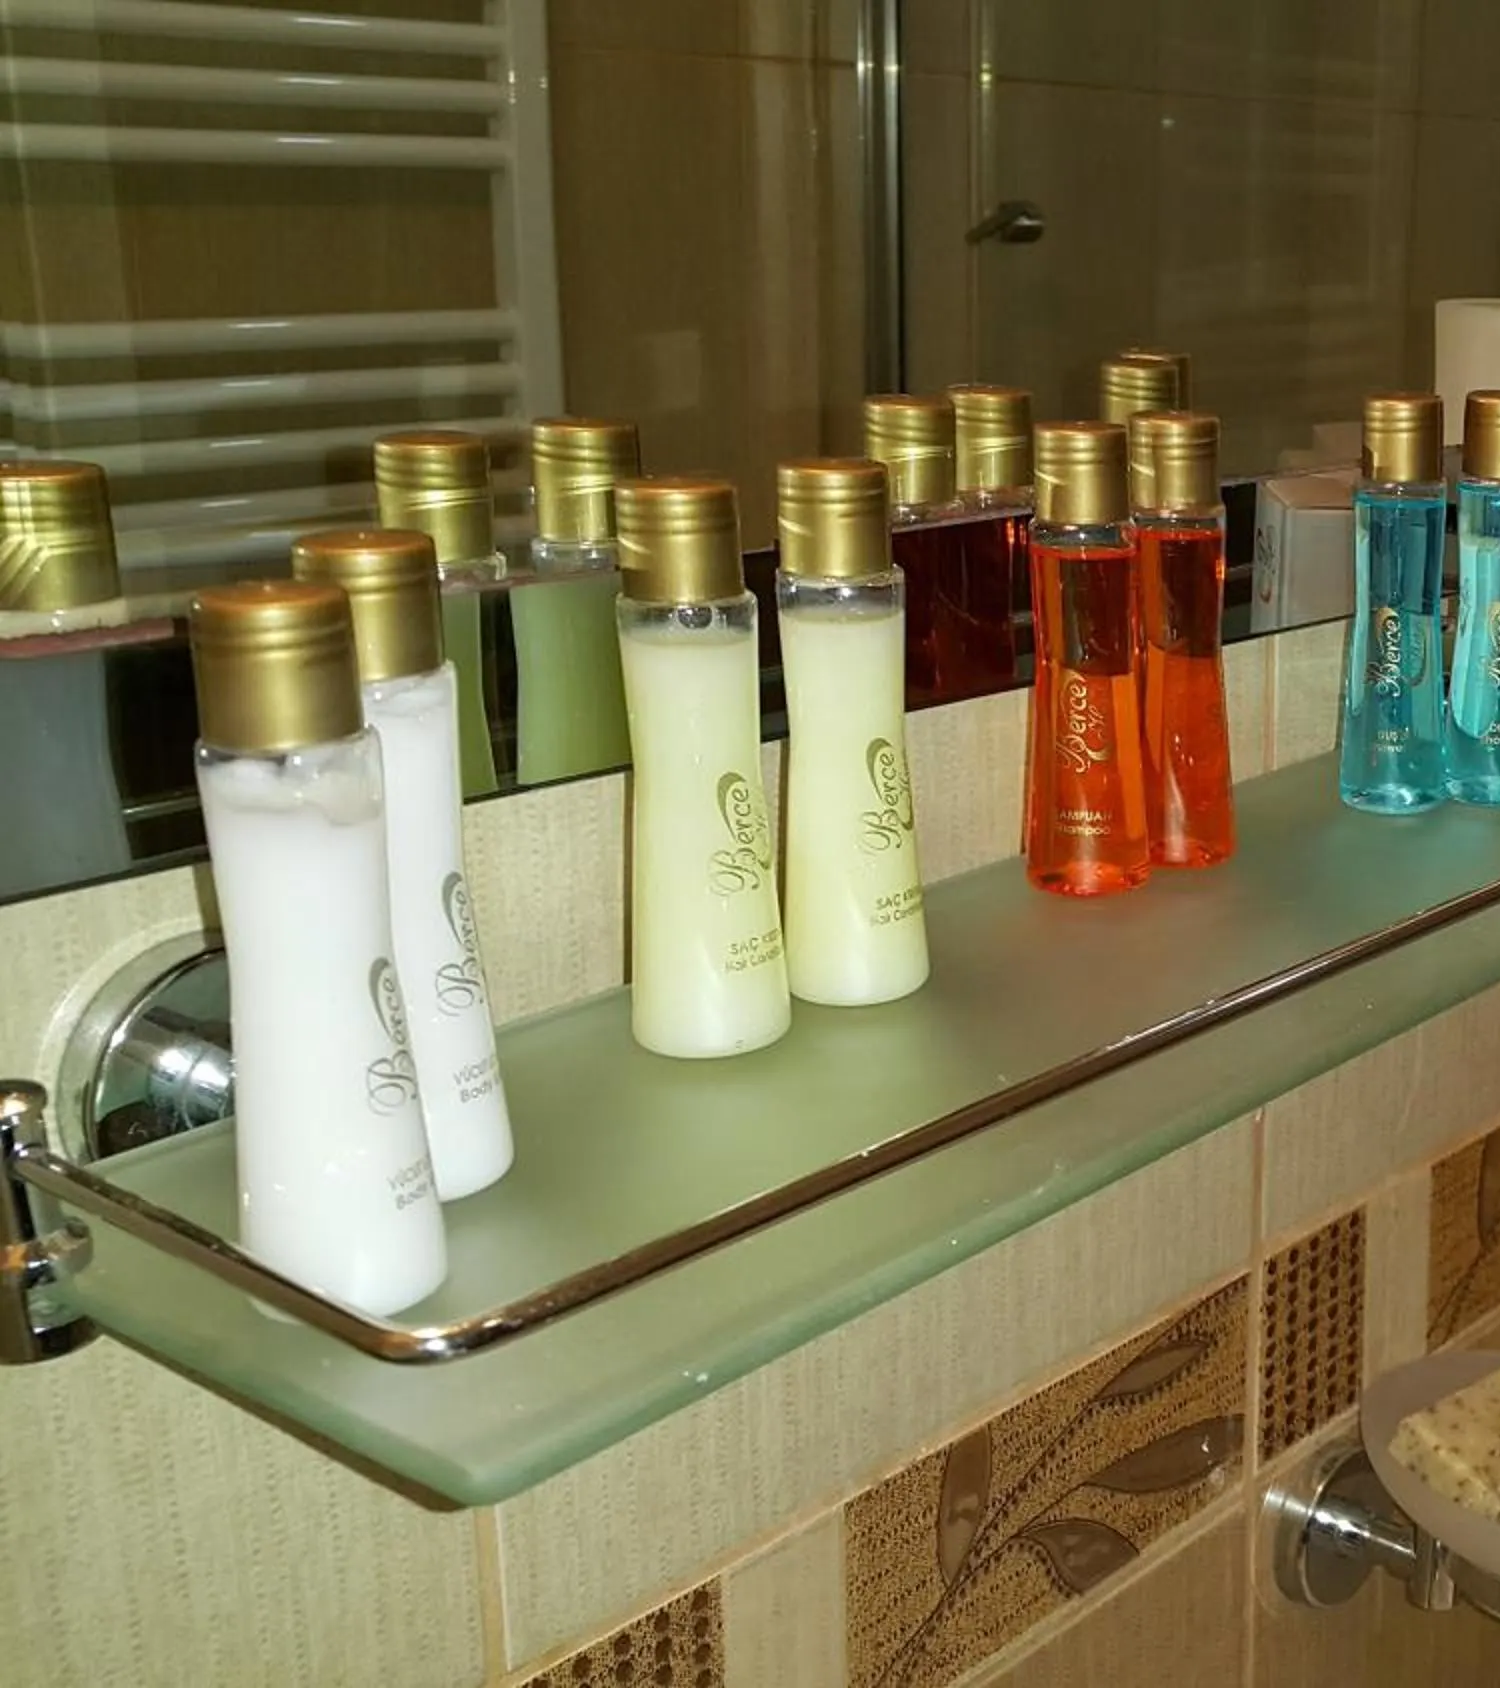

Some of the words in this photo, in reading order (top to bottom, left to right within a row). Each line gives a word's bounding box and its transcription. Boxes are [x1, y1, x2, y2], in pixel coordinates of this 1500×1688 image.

[1056, 682, 1088, 774] Berce
[708, 787, 761, 897] Berce
[858, 752, 904, 855] Berce
